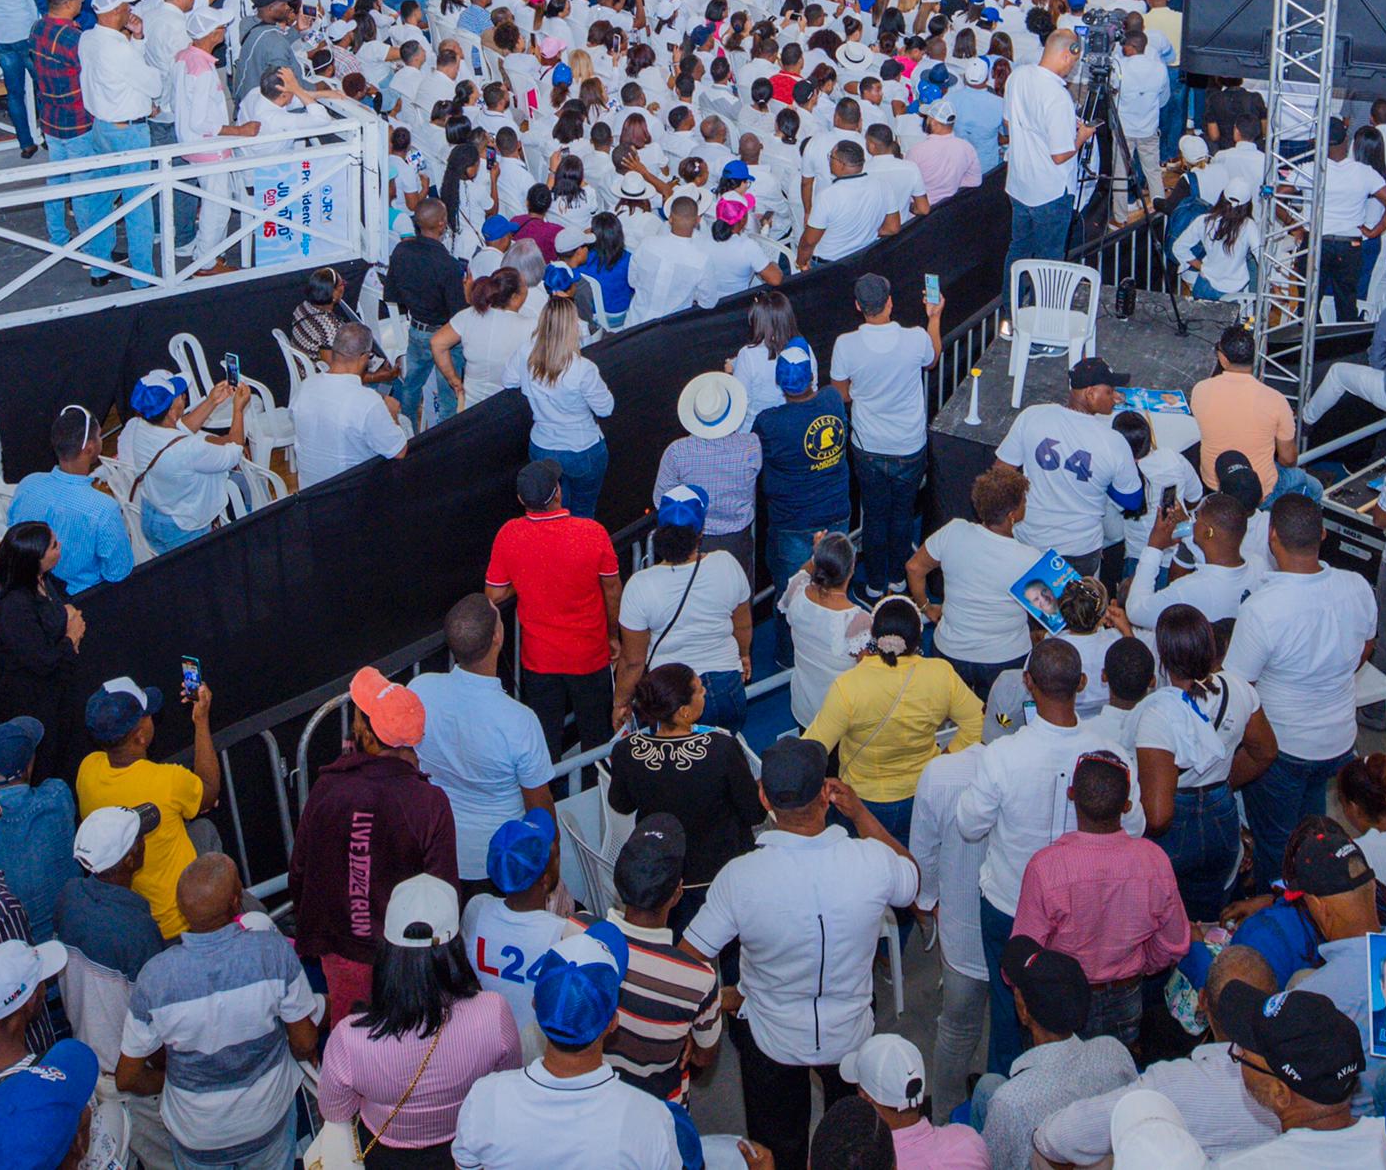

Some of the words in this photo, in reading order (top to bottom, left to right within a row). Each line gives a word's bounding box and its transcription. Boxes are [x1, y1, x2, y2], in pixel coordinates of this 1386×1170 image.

[808, 416, 836, 435] CHESS
[1035, 438, 1093, 481] 64
[351, 812, 374, 854] LIVE
[350, 897, 371, 937] RUN
